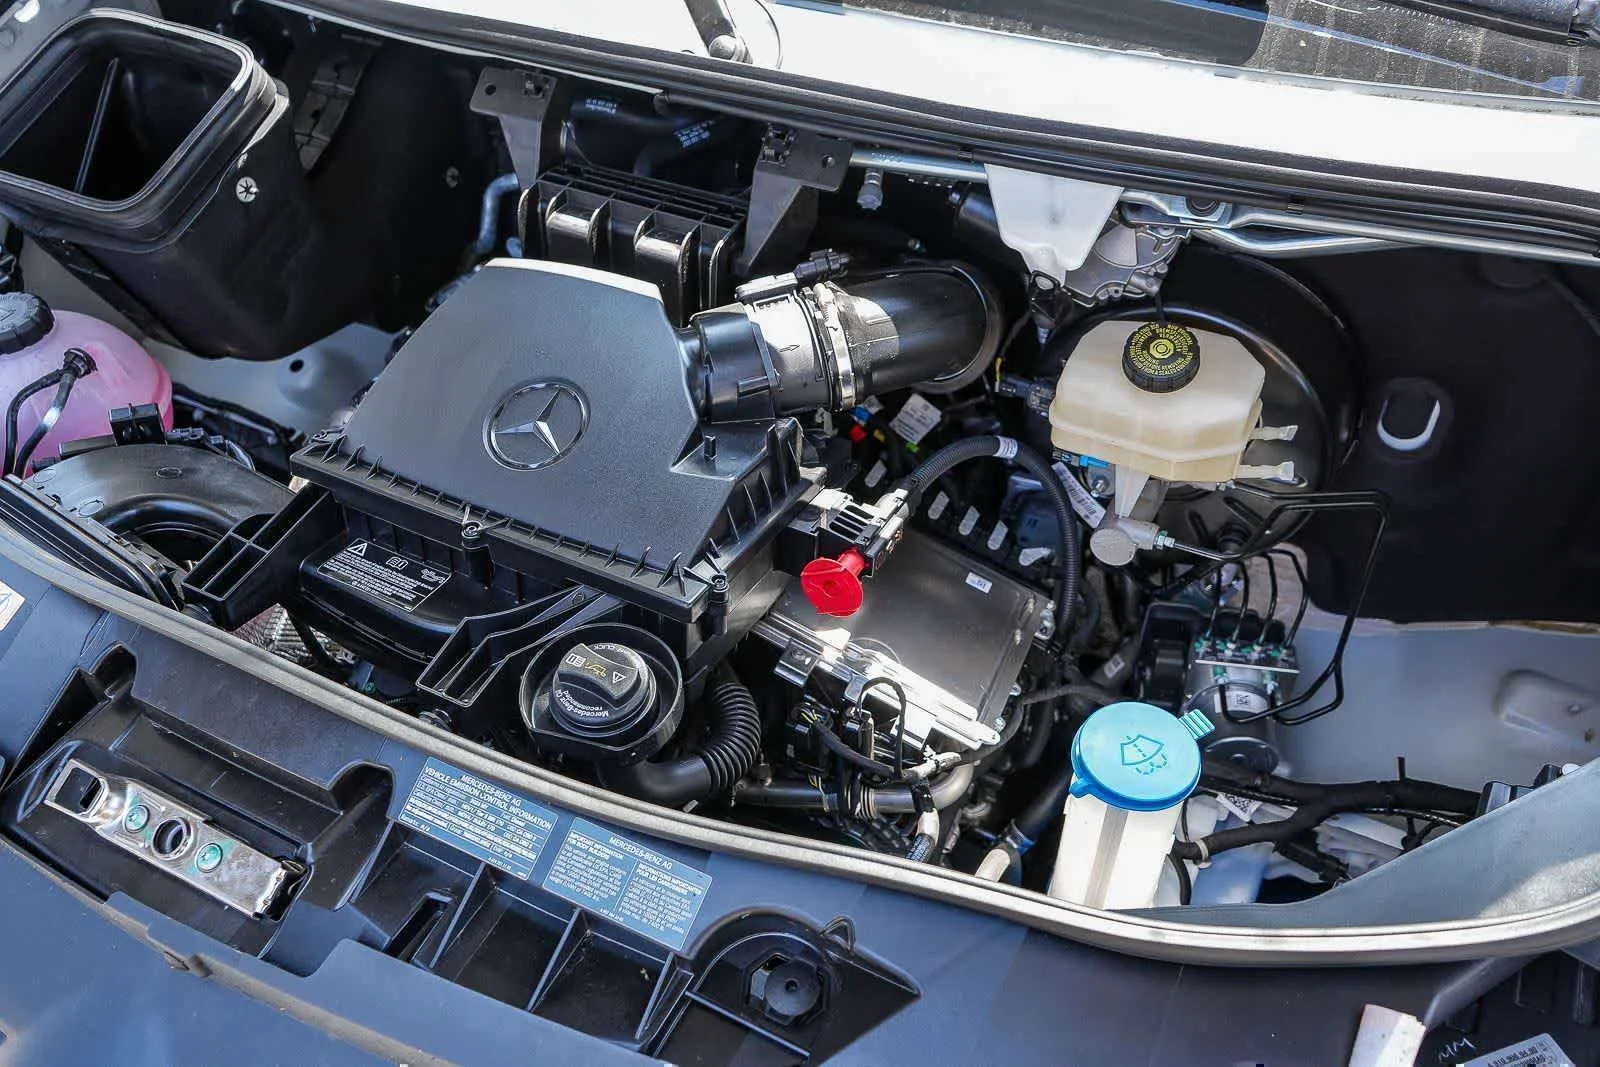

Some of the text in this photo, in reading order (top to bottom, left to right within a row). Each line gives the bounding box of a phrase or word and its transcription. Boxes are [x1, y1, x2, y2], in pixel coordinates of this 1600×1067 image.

[560, 696, 609, 717] Mercedes-Benz
[424, 766, 450, 783] VEHICLE
[449, 777, 480, 796] EMISSION
[479, 791, 510, 810] CONTROL
[508, 805, 552, 829] INFORMATION
[460, 774, 512, 802] MERCEDES-BENZ
[510, 797, 521, 806] AG
[608, 836, 672, 869] MERCEDES-BENZ AG
